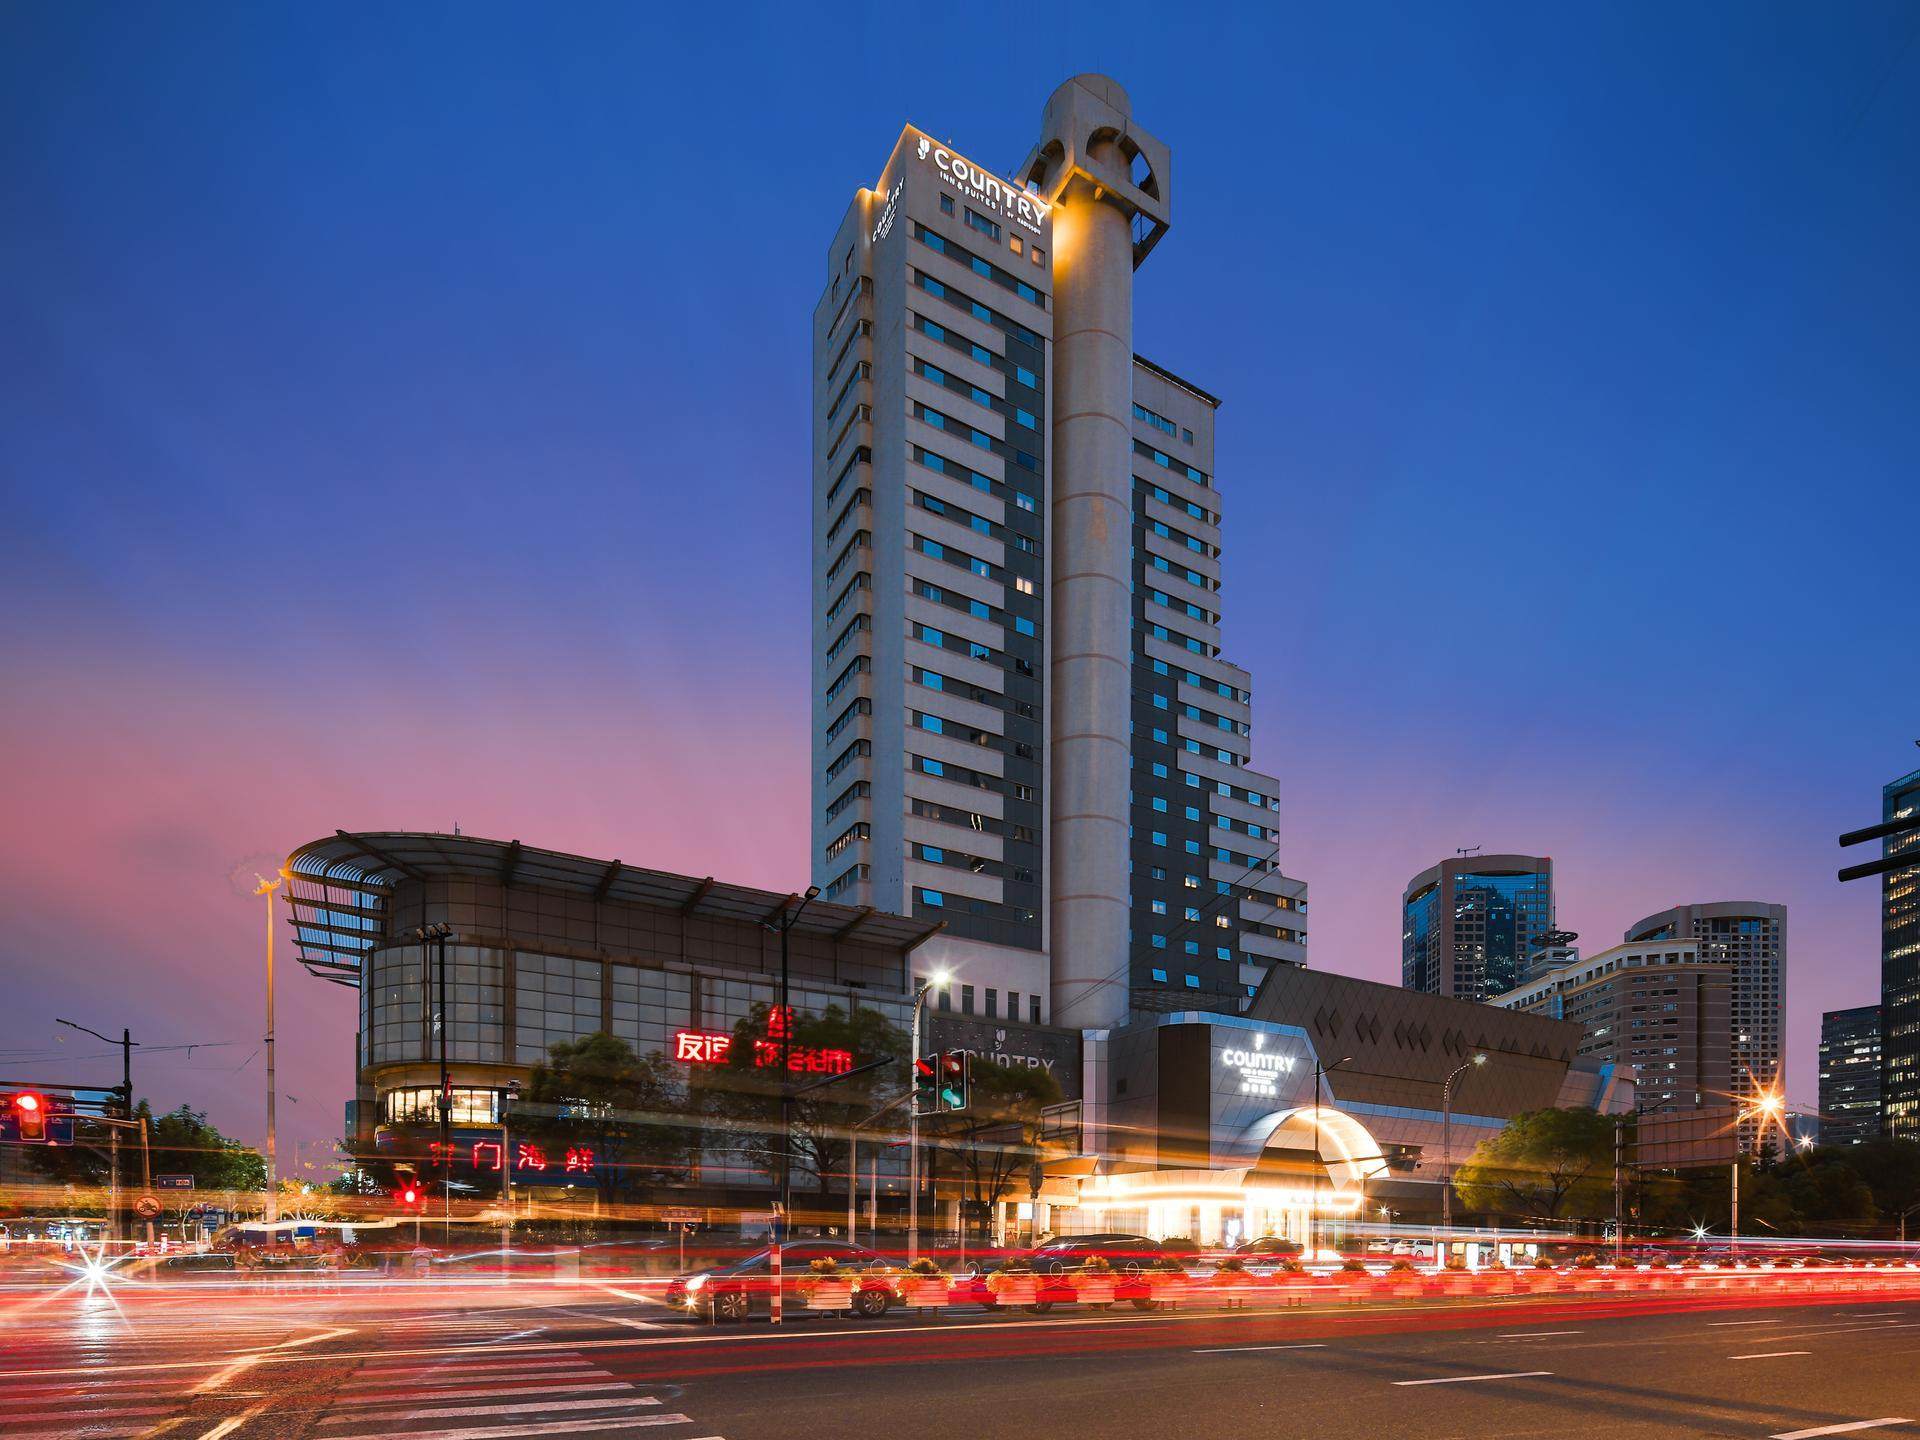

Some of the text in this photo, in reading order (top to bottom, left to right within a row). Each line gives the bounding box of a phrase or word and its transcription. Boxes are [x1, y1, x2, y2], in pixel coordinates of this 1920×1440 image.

[934, 148, 1046, 226] COUNTRY
[939, 171, 956, 187] INN
[872, 176, 904, 242] COUNTRY
[1222, 1048, 1296, 1073] COUNTRY
